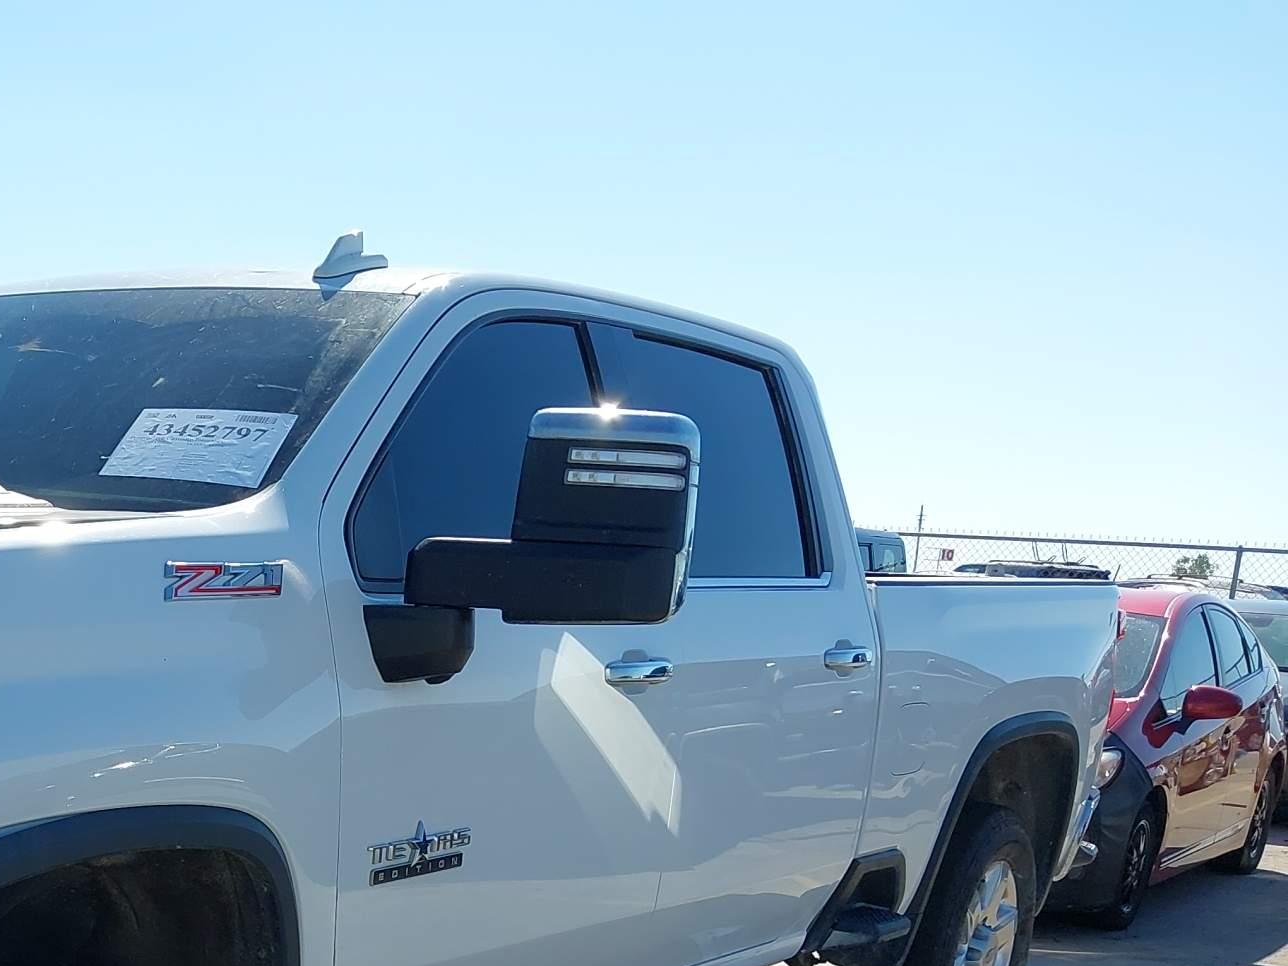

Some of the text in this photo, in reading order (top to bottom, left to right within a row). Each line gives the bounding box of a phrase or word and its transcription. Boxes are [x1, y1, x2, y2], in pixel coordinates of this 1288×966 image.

[143, 423, 268, 442] 43452797
[164, 560, 283, 601] Z71
[378, 857, 459, 881] EDITION
